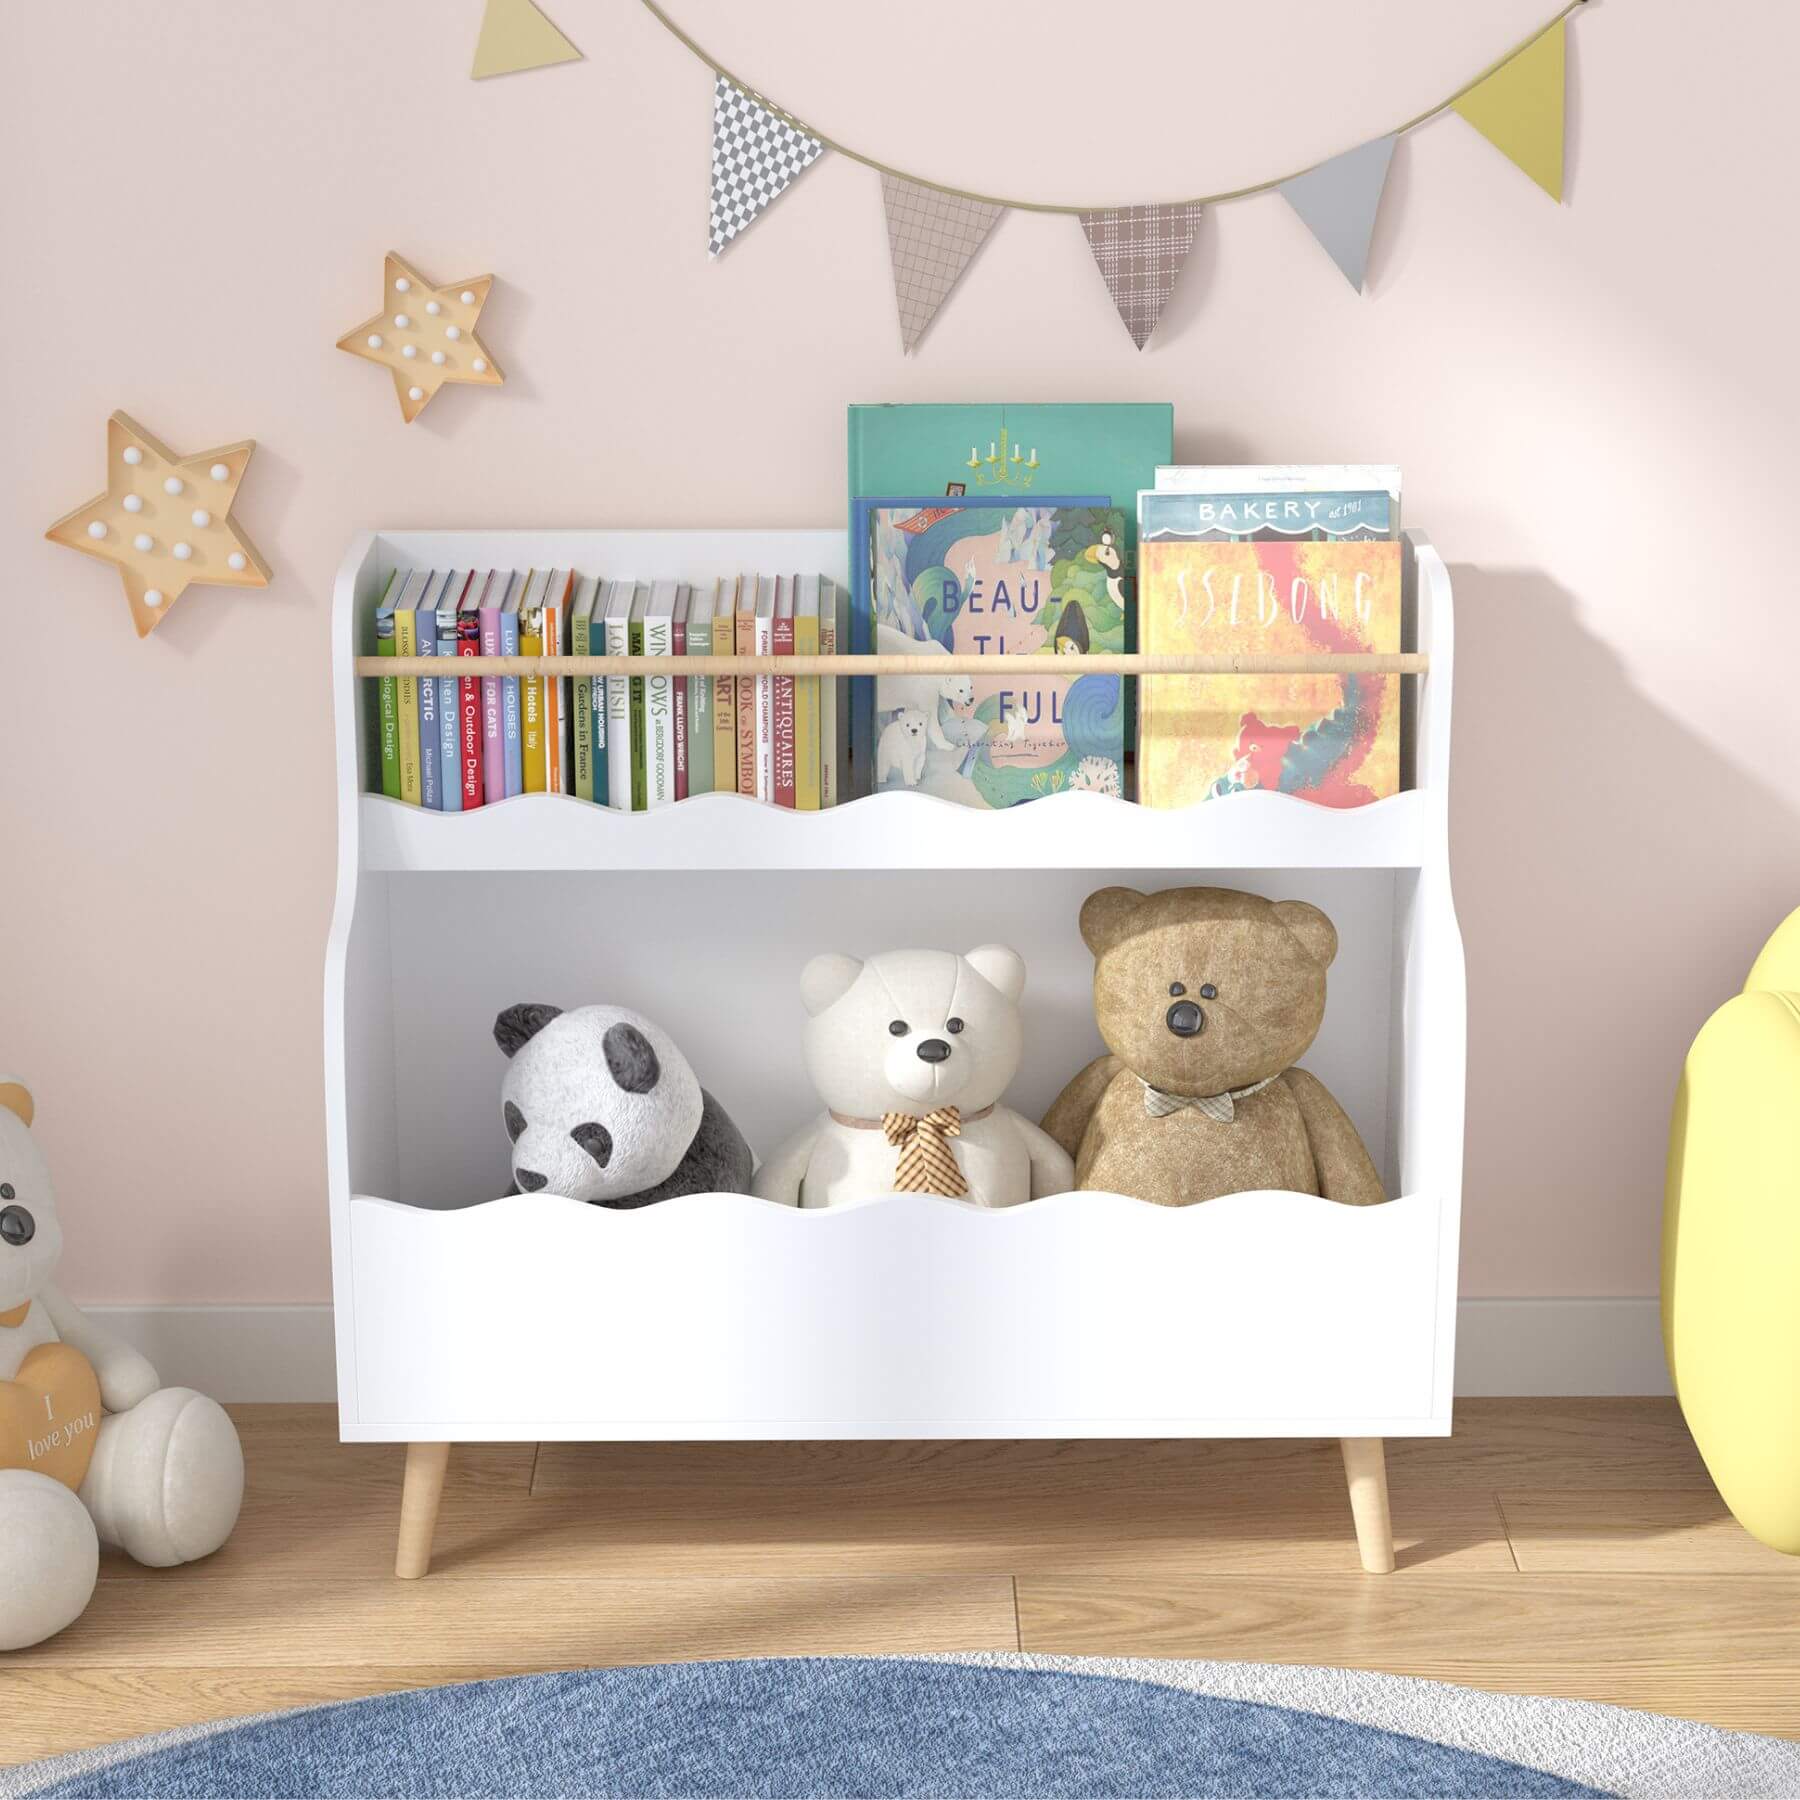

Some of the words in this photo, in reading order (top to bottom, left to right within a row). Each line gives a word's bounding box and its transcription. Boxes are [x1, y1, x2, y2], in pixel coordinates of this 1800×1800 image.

[1200, 501, 1321, 521] BAKERY
[943, 579, 1063, 613] BEAU-
[421, 639, 434, 721] ANRCTIC
[443, 650, 454, 704] Khen
[650, 624, 668, 716] WINOWS
[382, 676, 393, 718] ological
[465, 693, 475, 701] &
[486, 682, 497, 705] FOR
[507, 685, 516, 739] HOUSES
[527, 687, 537, 723] Hotels
[578, 683, 588, 728] Gardens
[633, 689, 642, 704] IT
[675, 691, 684, 716] FRANK
[739, 677, 754, 713] OOK
[1000, 691, 1063, 724] FUL
[442, 711, 455, 758] Design
[465, 705, 477, 754] Outdoor
[487, 708, 498, 738] CATS
[527, 731, 537, 750] Italy
[579, 730, 588, 741] in
[676, 716, 685, 741] LLOYD
[761, 701, 769, 743] CHAMPIONS
[780, 676, 793, 787] ANTIQUAIRES
[384, 722, 394, 760] Design
[655, 725, 664, 762] BERGDORF
[677, 742, 685, 771] WRIGHT
[425, 748, 434, 778] Michael
[465, 758, 477, 796] Design
[579, 743, 589, 780] France
[739, 729, 754, 796] SYMBOL
[655, 763, 665, 801] GOODMAN
[44, 1394, 55, 1421] I
[27, 1431, 61, 1461] love
[64, 1411, 95, 1448] you
